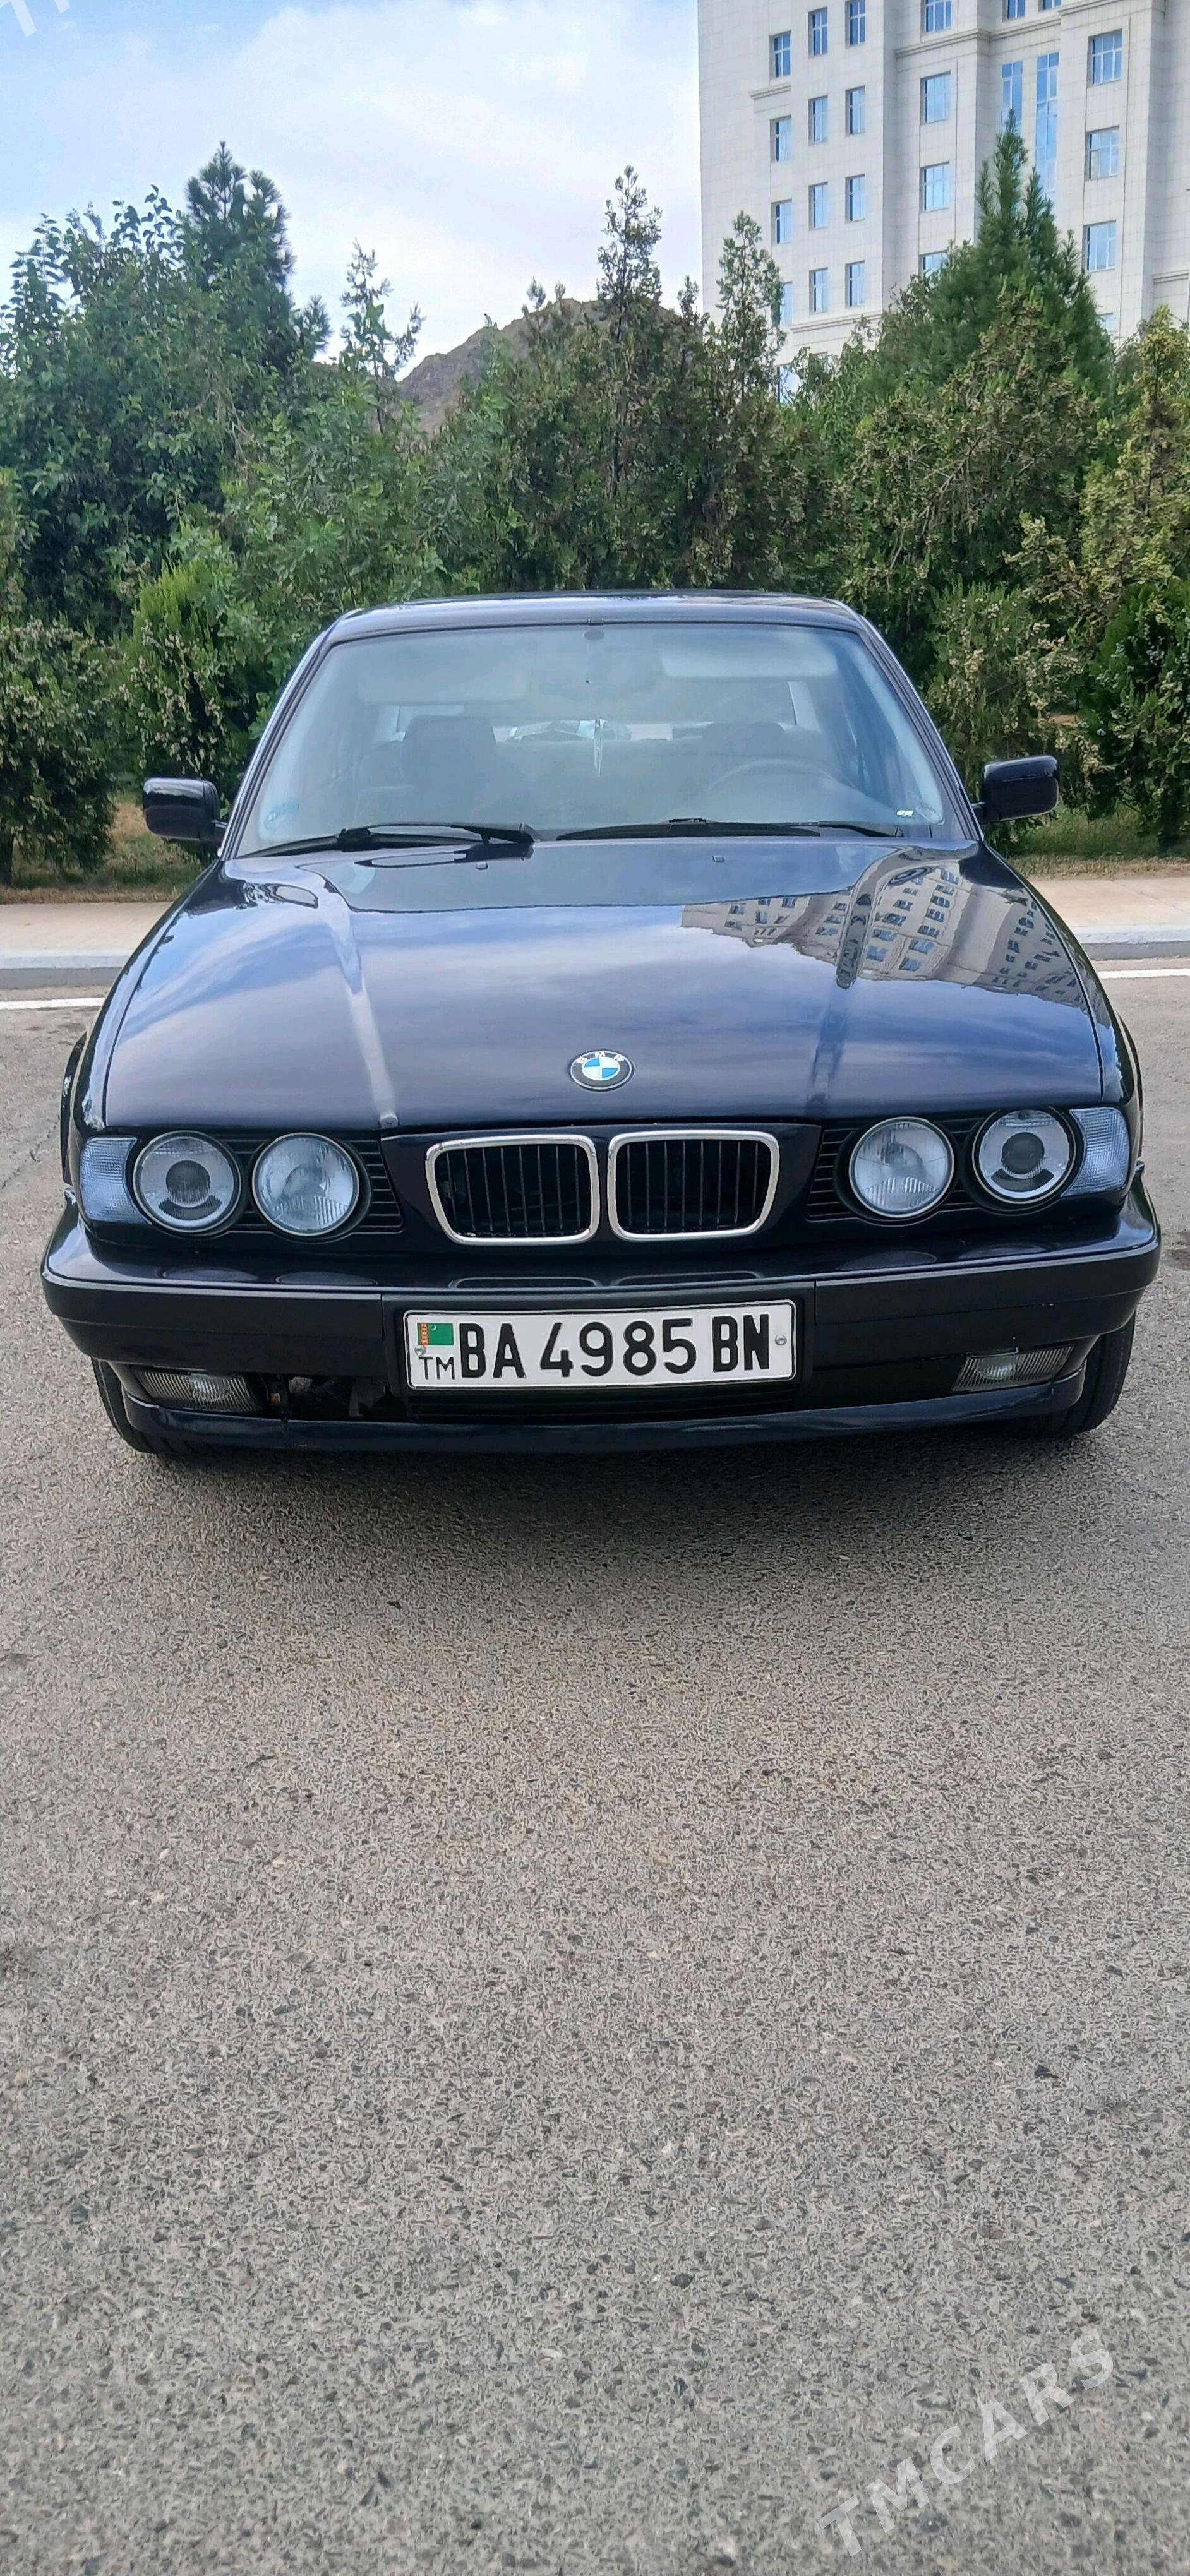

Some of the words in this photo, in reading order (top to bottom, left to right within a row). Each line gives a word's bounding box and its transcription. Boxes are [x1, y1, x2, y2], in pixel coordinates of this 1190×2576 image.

[418, 1356, 455, 1380] TM
[459, 1323, 526, 1378] BA
[540, 1318, 696, 1378] 4985
[712, 1314, 769, 1373] BN
